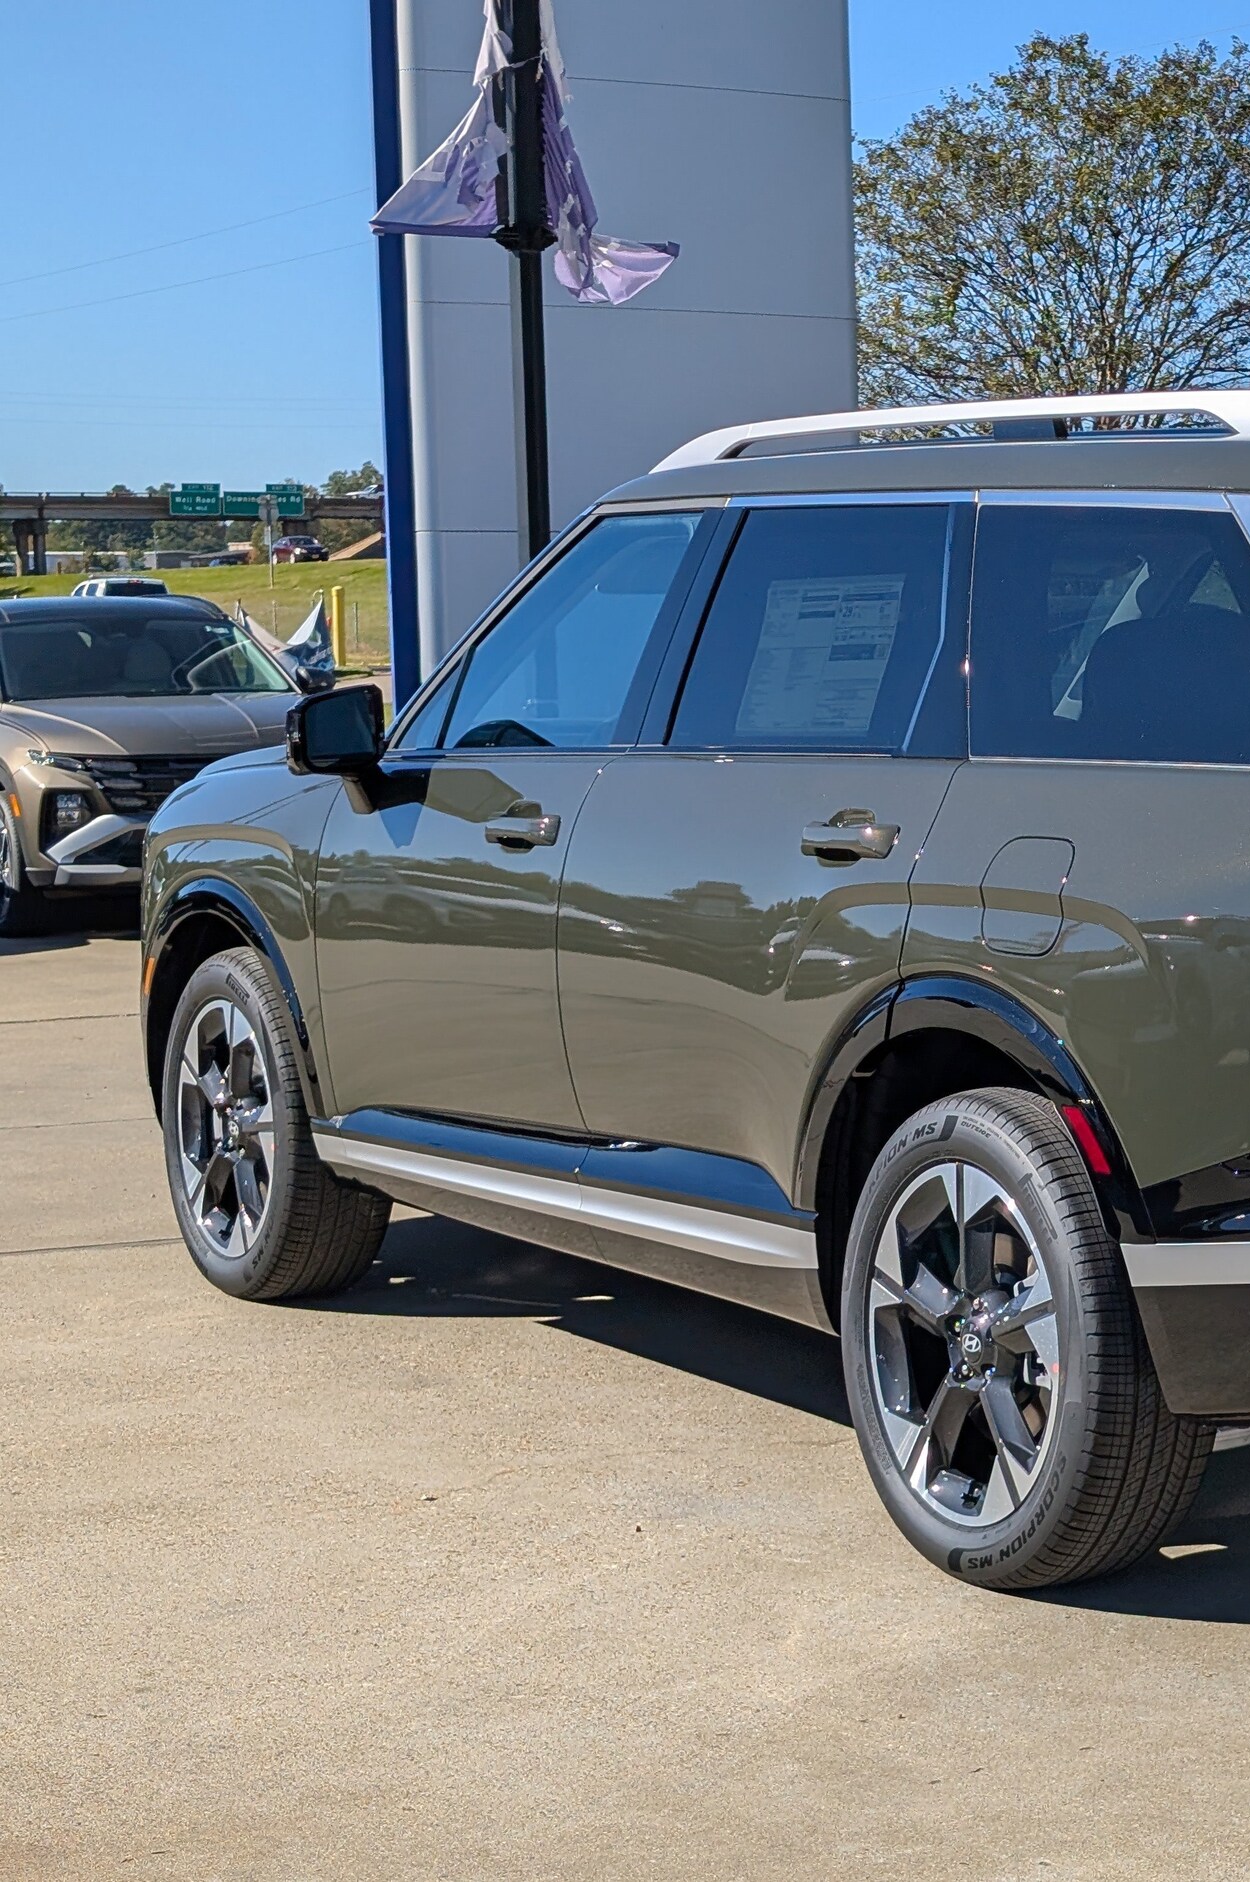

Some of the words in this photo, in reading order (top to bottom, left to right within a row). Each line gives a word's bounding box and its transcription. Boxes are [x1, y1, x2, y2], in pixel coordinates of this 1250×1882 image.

[196, 496, 216, 504] Road
[912, 1121, 938, 1141] MS
[1000, 1451, 1067, 1562] SCORPION
[967, 1554, 993, 1569] MS
